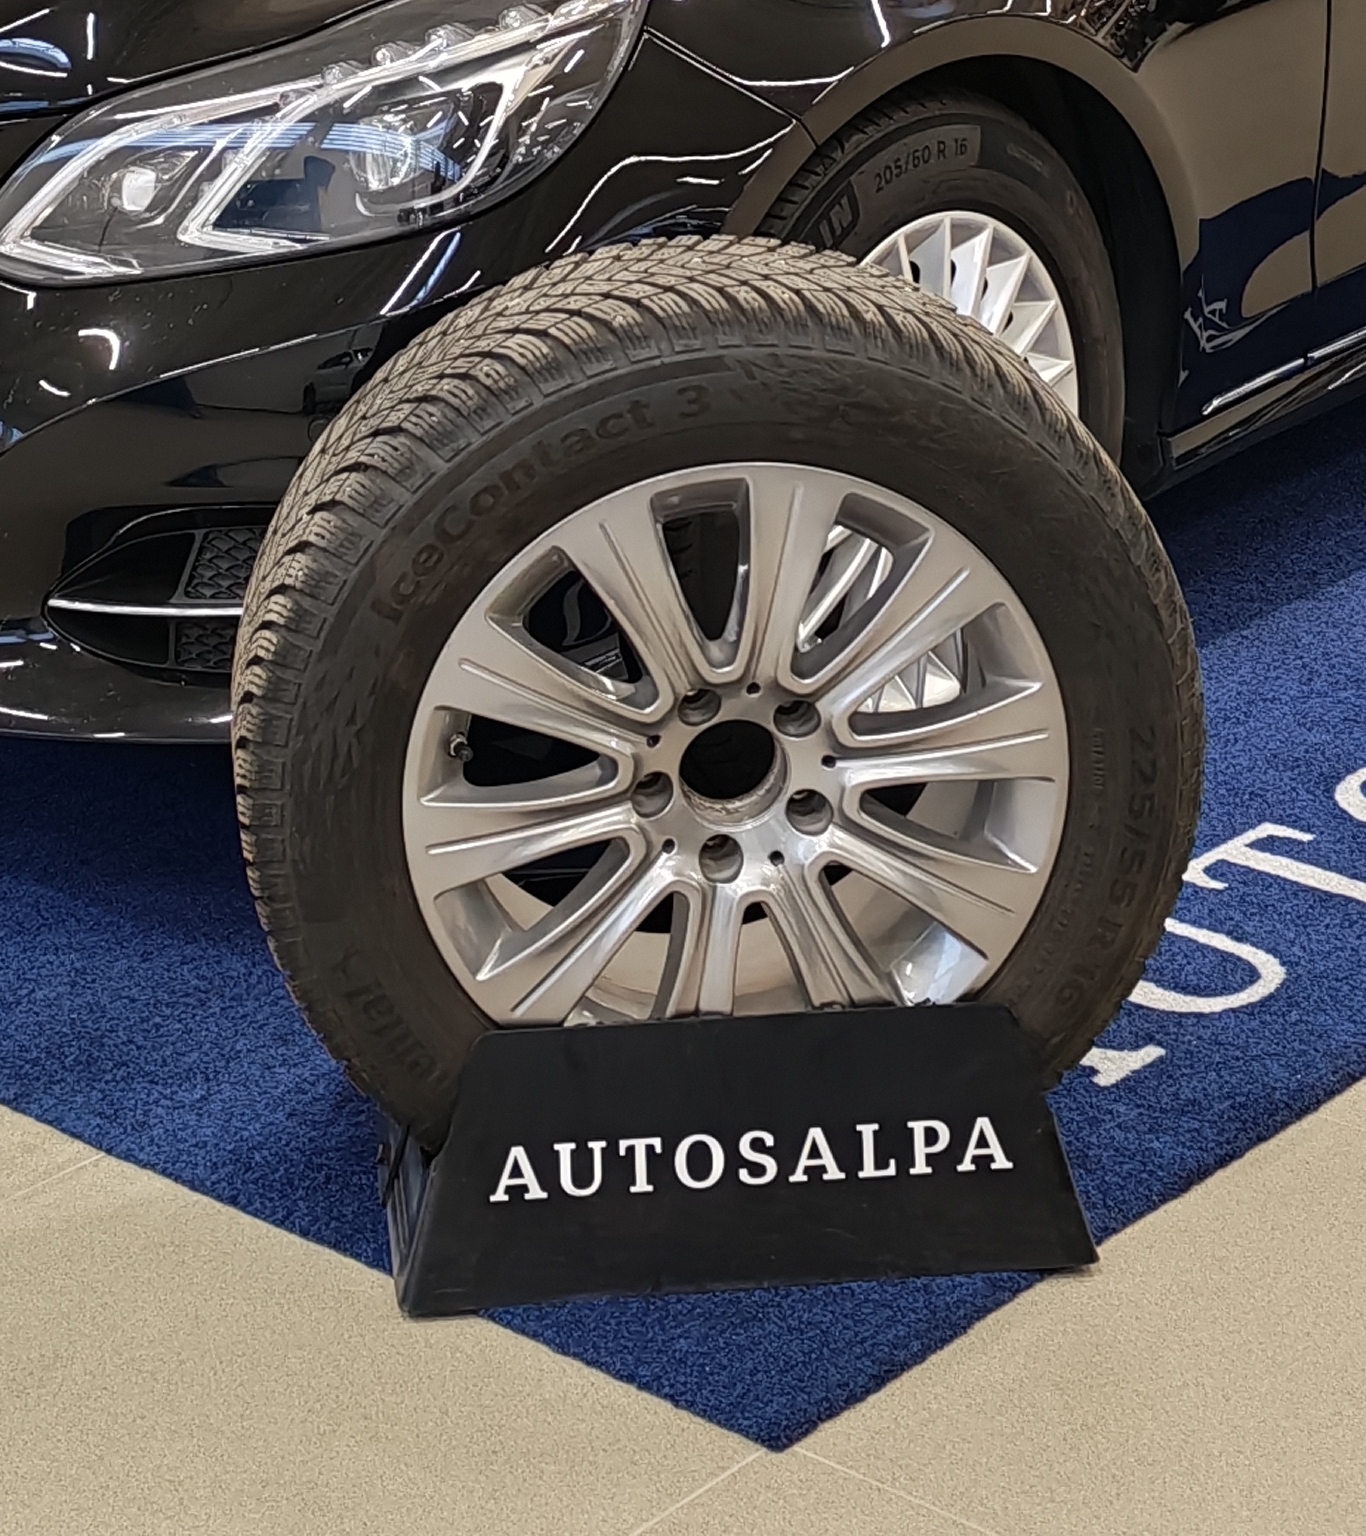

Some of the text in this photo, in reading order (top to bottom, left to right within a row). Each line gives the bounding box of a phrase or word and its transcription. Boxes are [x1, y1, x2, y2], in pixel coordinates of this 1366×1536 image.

[936, 140, 947, 161] R
[954, 137, 969, 156] 16
[369, 382, 712, 624] IceContact 3
[489, 1116, 1014, 1202] AUTOSALPA
